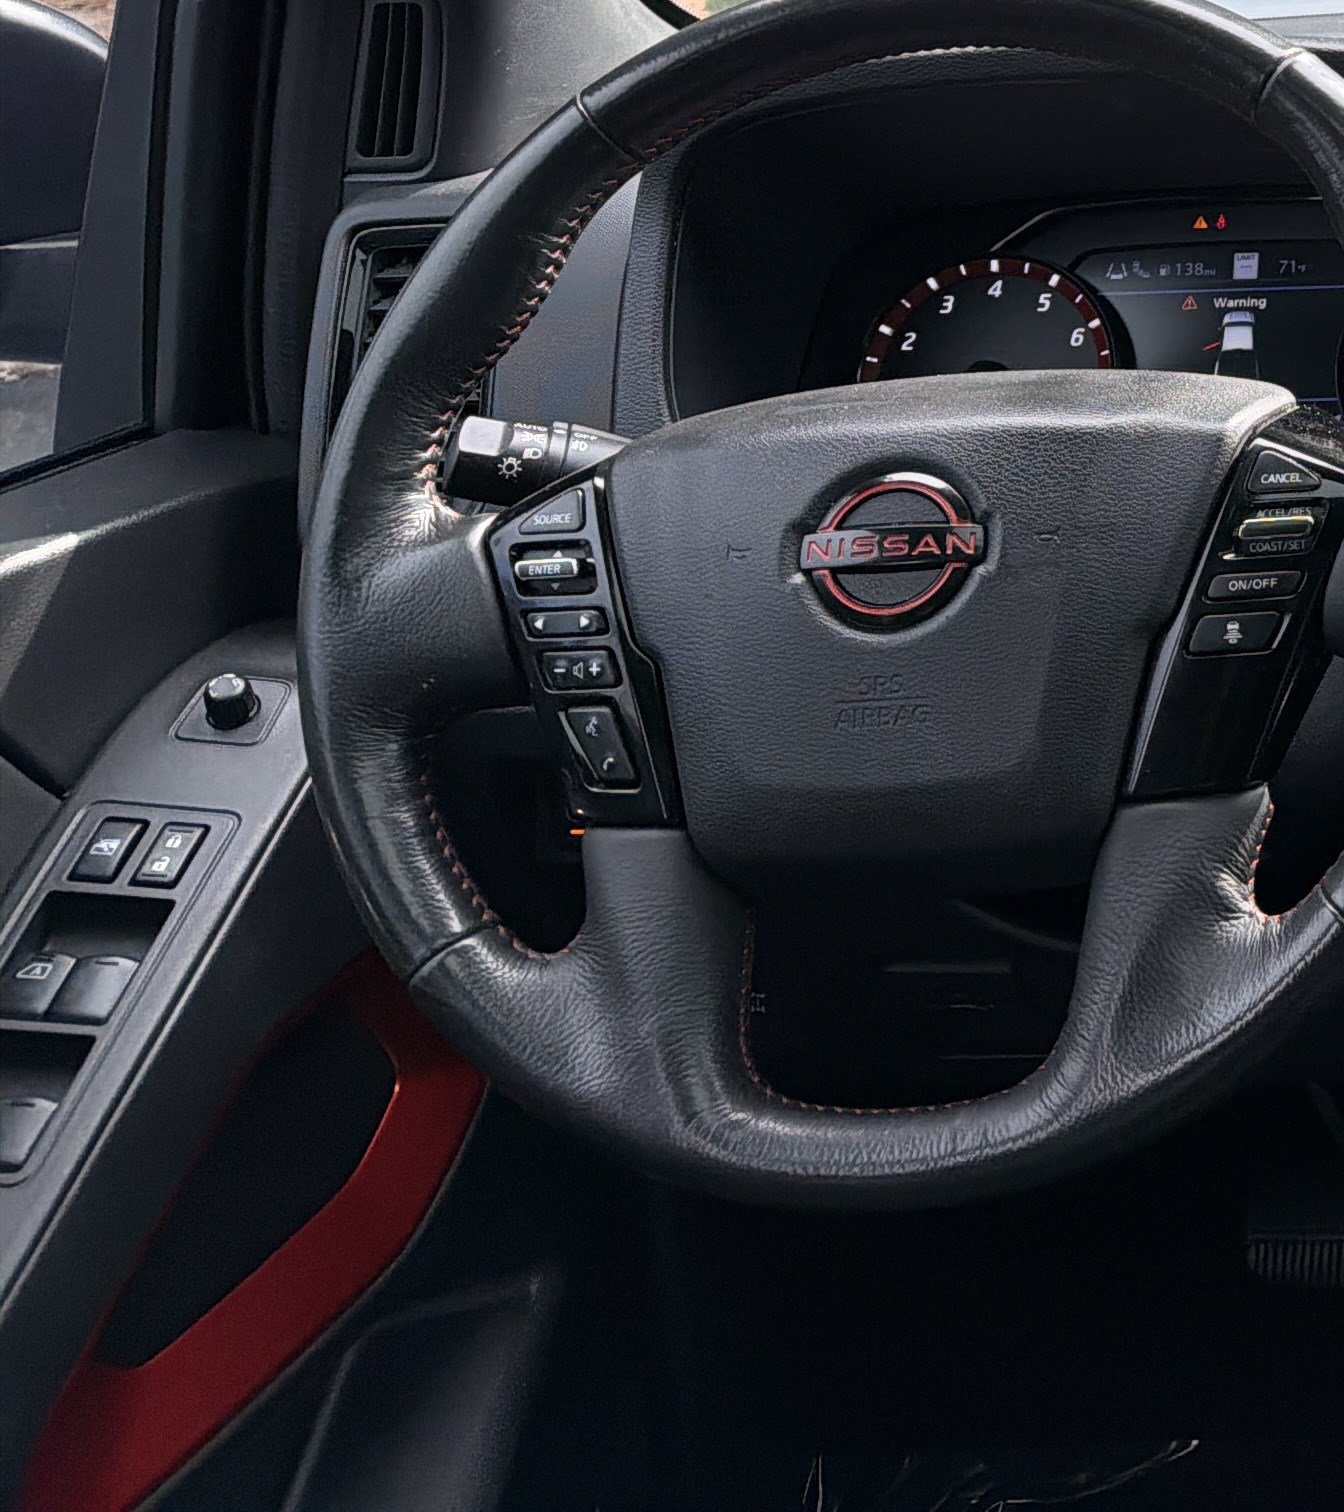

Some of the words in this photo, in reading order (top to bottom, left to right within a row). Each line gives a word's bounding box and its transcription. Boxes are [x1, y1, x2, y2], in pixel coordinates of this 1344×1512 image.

[987, 279, 1003, 298] 4
[939, 295, 954, 314] 3
[1036, 293, 1052, 312] 5
[1213, 296, 1267, 310] Warning
[901, 332, 917, 351] 2
[1070, 327, 1085, 347] 6
[1260, 472, 1302, 484] CANCEL
[533, 512, 572, 525] SOURCE
[1256, 506, 1312, 517] ACCEL/RES
[806, 532, 976, 564] NISSAN
[1249, 539, 1306, 553] COAST/SET
[528, 564, 561, 576] ENTER
[1228, 578, 1278, 591] ON/OFF
